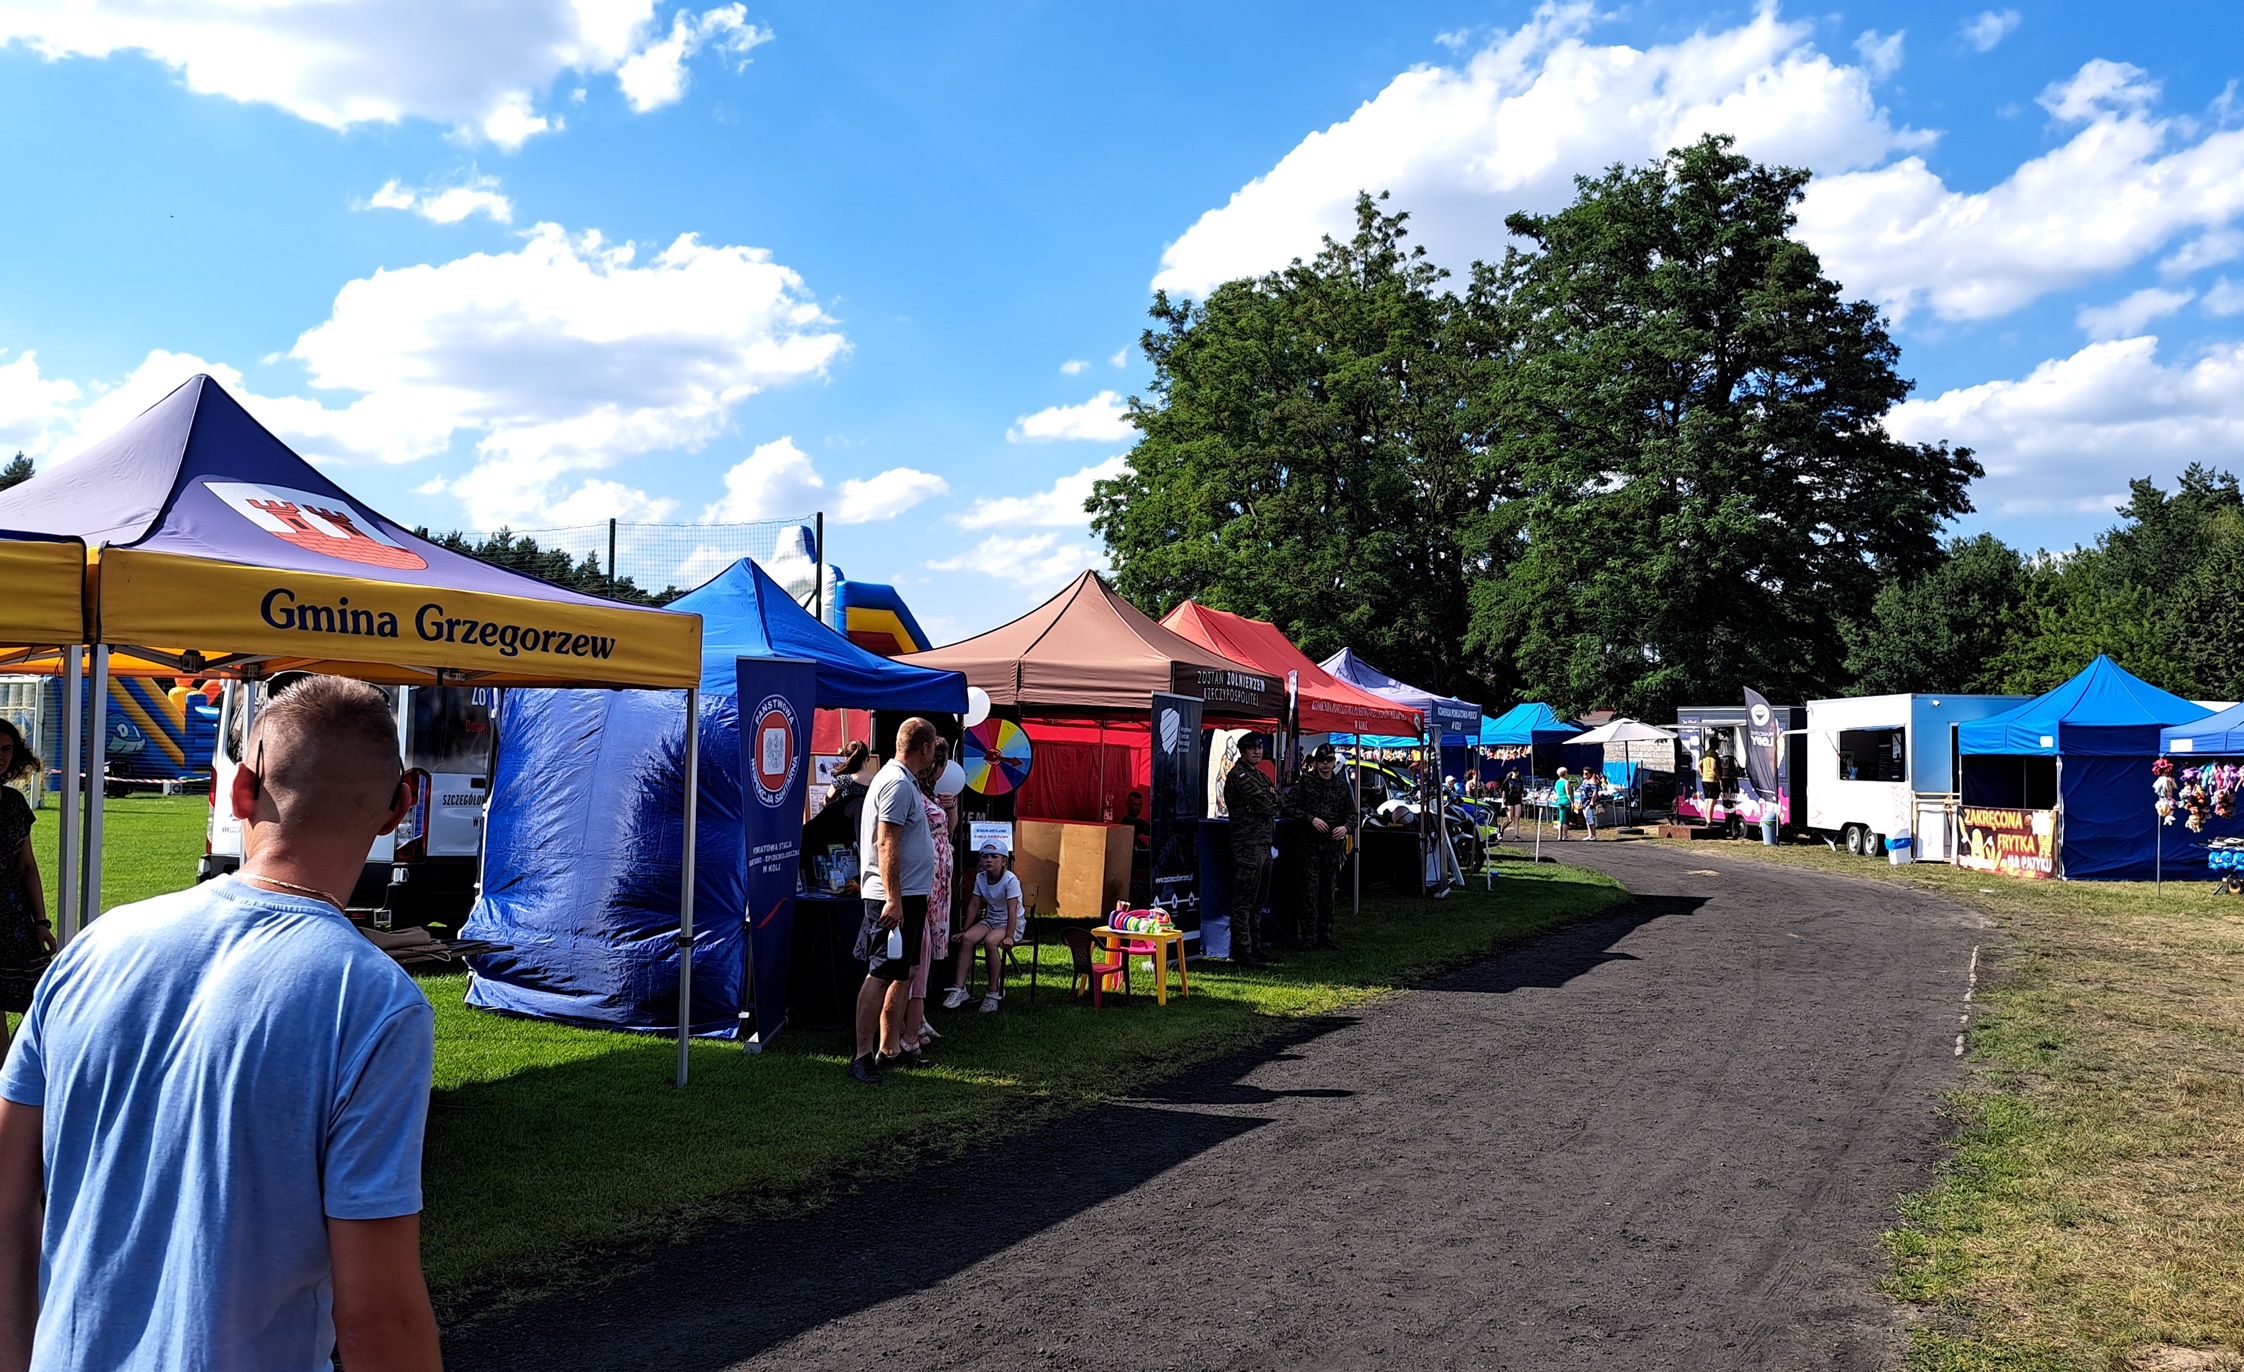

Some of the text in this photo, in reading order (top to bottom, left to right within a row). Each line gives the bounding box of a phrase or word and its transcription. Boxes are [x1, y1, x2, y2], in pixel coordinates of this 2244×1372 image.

[260, 588, 616, 660] Gmina Grzegorzew
[1203, 687, 1259, 707] RZECZYPOSPOLITEJ
[755, 699, 795, 725] PAŃSTWOWA
[774, 756, 799, 803] SANITARNA
[1964, 808, 2023, 831] ZAKRĘCONA
[1997, 833, 2036, 854] FRYTKA
[2006, 854, 2020, 869] NA
[2021, 856, 2053, 874] PATYKU
